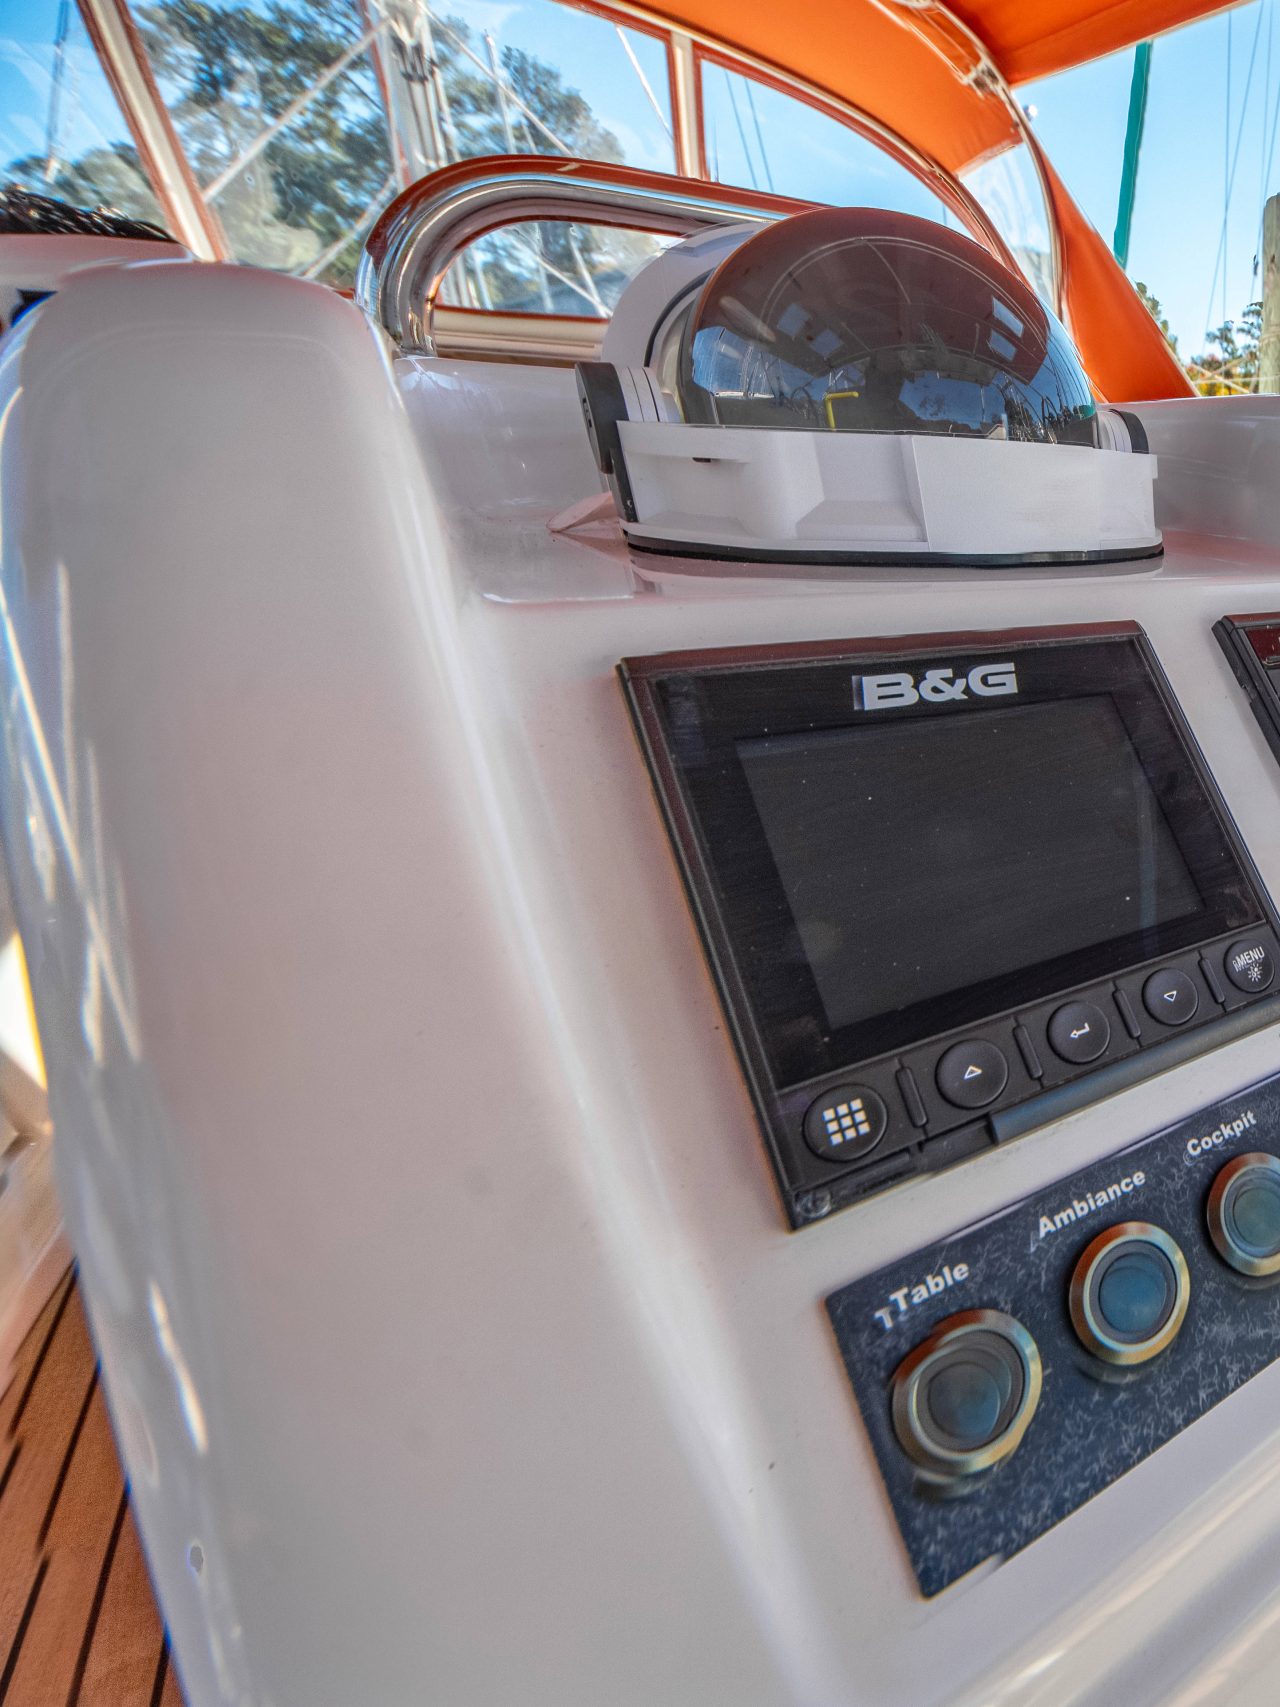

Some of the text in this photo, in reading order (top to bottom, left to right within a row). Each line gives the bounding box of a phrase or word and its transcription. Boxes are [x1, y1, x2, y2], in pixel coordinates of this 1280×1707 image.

[861, 662, 1018, 711] B&G
[1233, 946, 1265, 970] MENU
[1185, 1109, 1257, 1156] Cockpit
[1038, 1170, 1146, 1238] Ambiance
